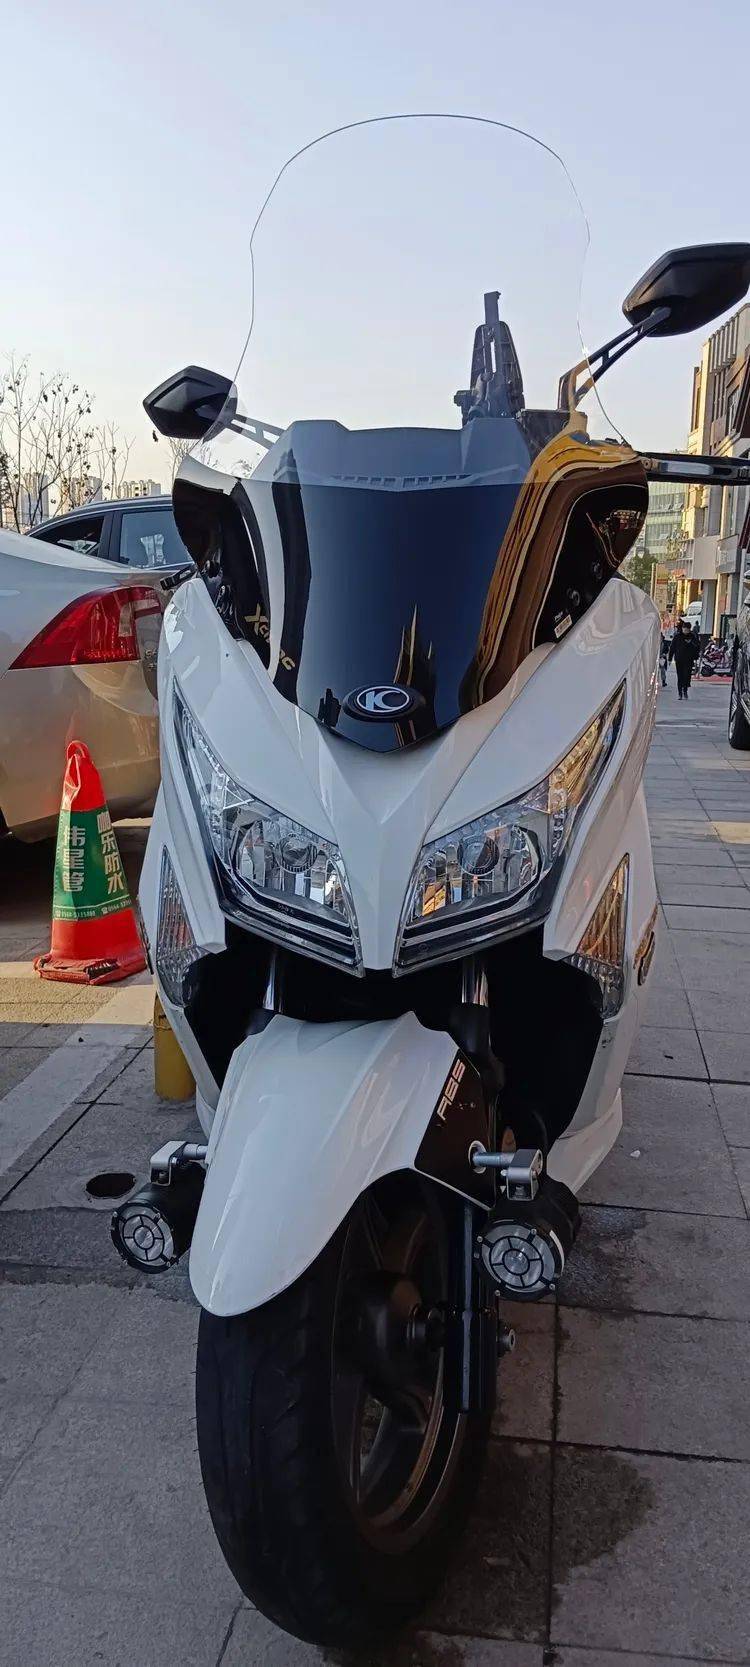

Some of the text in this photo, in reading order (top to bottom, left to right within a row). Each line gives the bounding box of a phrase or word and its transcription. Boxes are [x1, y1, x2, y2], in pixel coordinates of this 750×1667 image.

[62, 825, 86, 892] 伟星管
[437, 1059, 466, 1121] ABS
